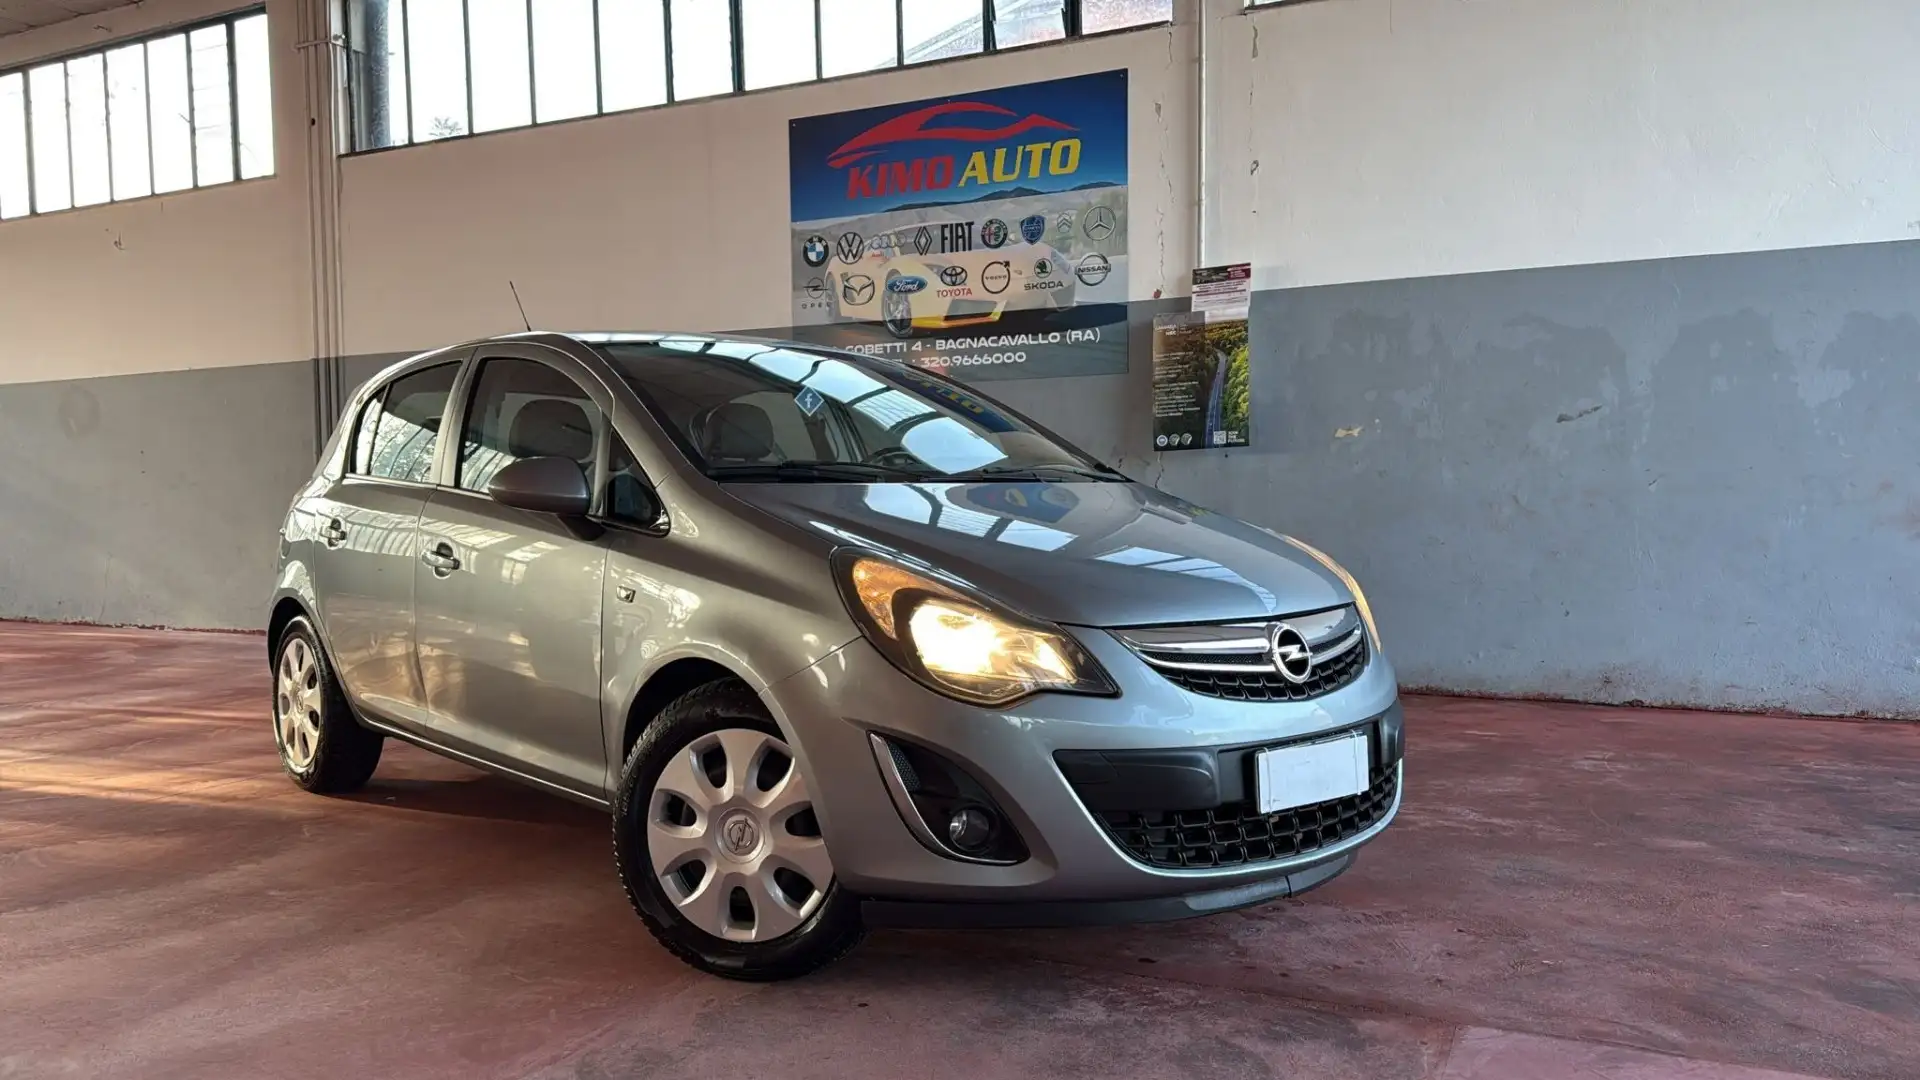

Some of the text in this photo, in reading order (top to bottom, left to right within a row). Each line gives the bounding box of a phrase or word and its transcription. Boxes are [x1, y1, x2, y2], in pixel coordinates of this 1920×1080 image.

[846, 138, 1082, 199] KIMO AUTO
[940, 221, 975, 254] FIAT
[1077, 265, 1109, 274] NISSAN
[893, 280, 919, 293] Ford
[936, 287, 973, 298] TOYOTA
[911, 341, 922, 352] 4
[935, 332, 1061, 351] BAGNACAVALLO
[1066, 327, 1101, 344] (RA)
[920, 351, 1027, 369] 320.9666000
